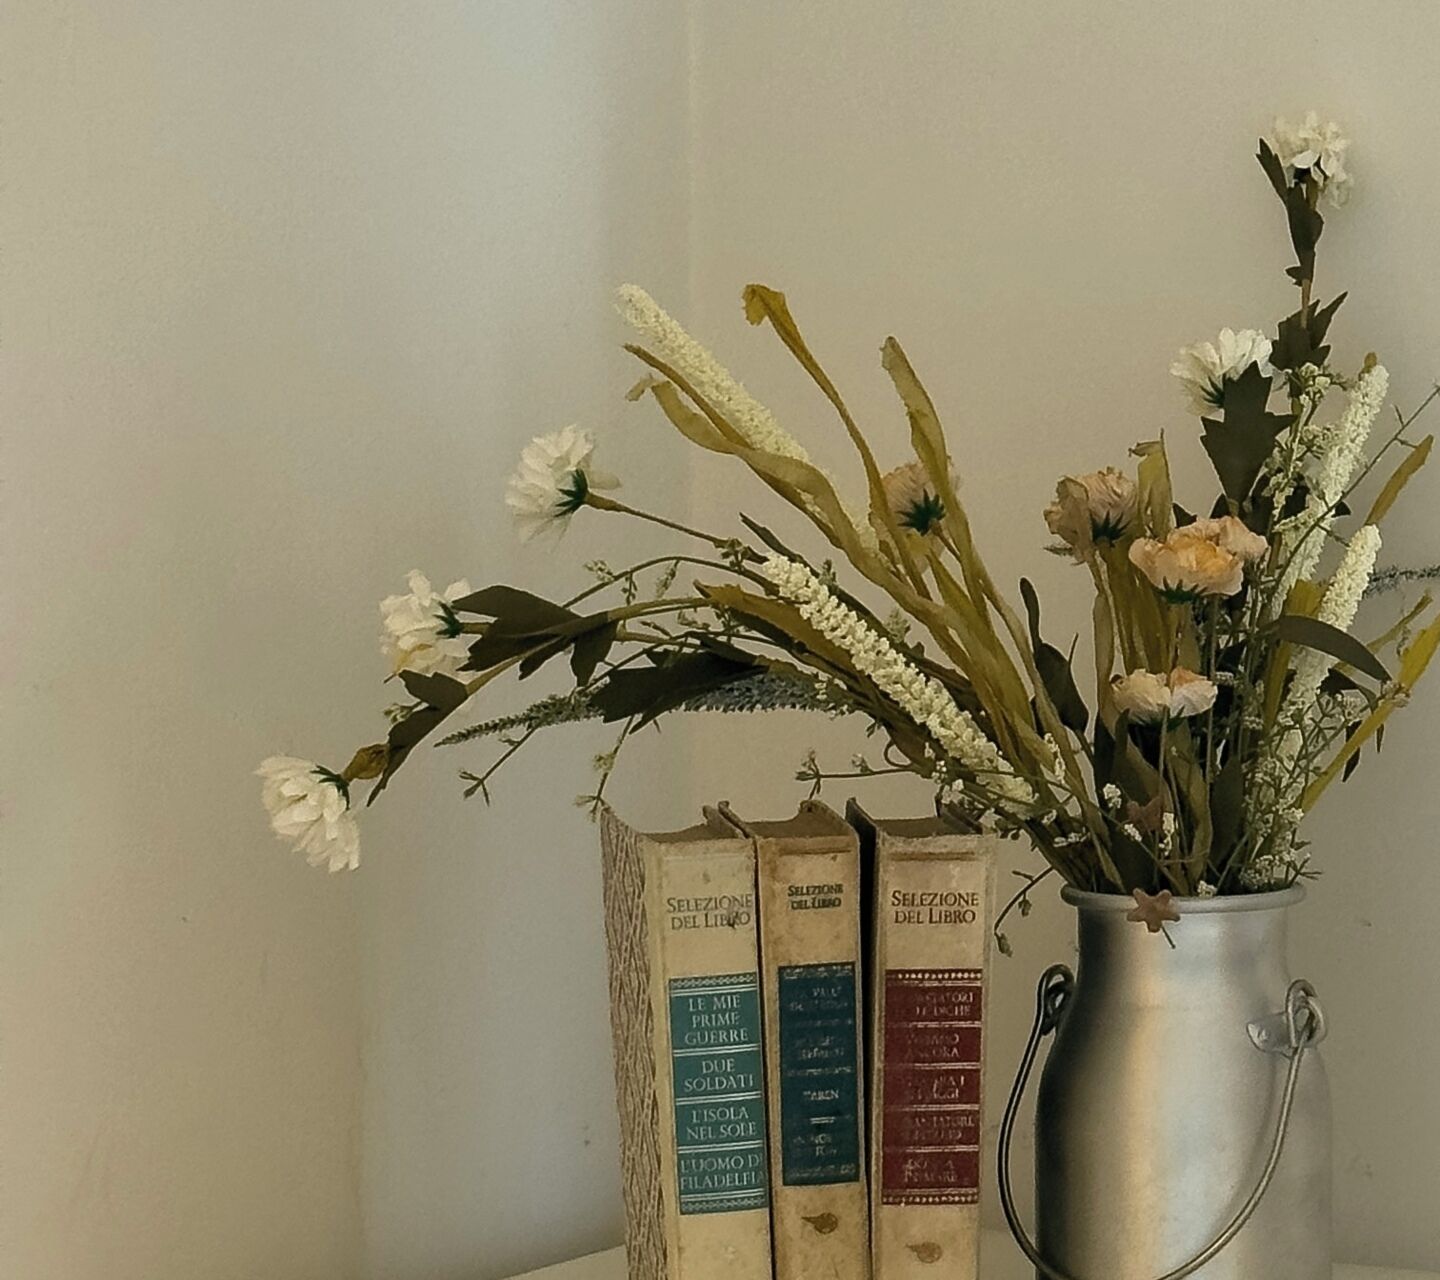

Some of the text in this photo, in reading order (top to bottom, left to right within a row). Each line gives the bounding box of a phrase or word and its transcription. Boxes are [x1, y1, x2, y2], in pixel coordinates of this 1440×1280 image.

[787, 883, 844, 897] SELEZIONE
[891, 890, 979, 908] SELEZIONE
[666, 894, 753, 914] SELEZIONE
[671, 911, 751, 931] DEL LIBRO
[894, 907, 976, 925] DEL LIBRO
[688, 994, 741, 1012] LE MIE
[692, 1012, 740, 1029] PRIME
[684, 1027, 749, 1045] GUERRE
[702, 1058, 736, 1074] DUE
[683, 1074, 754, 1093] SOLDATI
[686, 1125, 717, 1141] NEL
